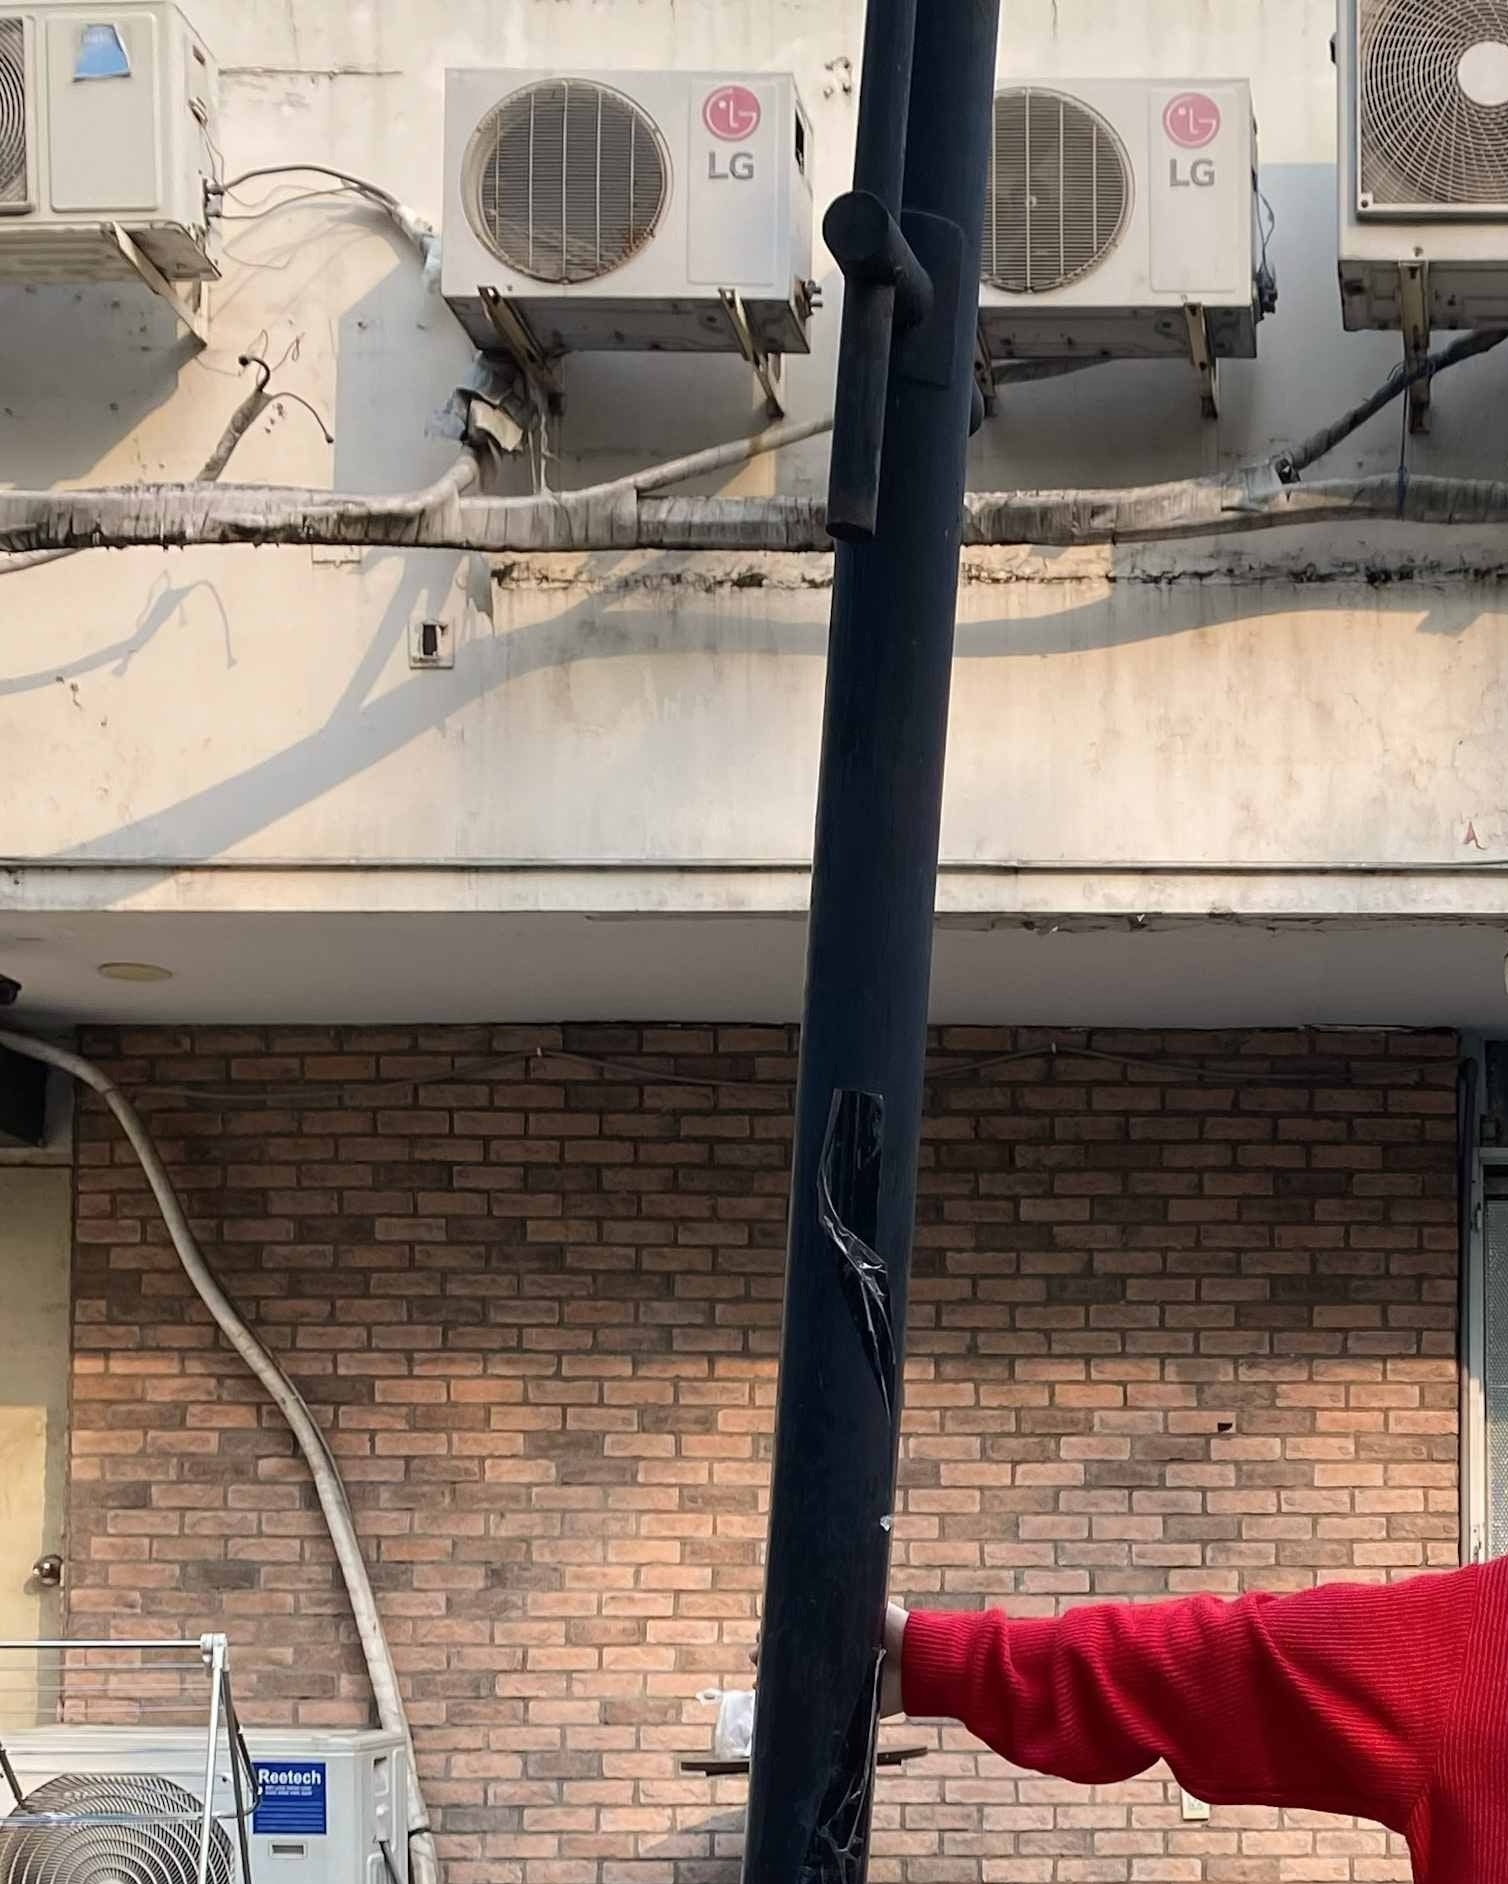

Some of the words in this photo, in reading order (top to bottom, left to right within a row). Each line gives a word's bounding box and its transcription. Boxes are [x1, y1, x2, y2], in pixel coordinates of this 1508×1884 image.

[708, 151, 754, 180] LG
[1169, 158, 1215, 187] LG
[258, 1768, 321, 1785] Reetech
